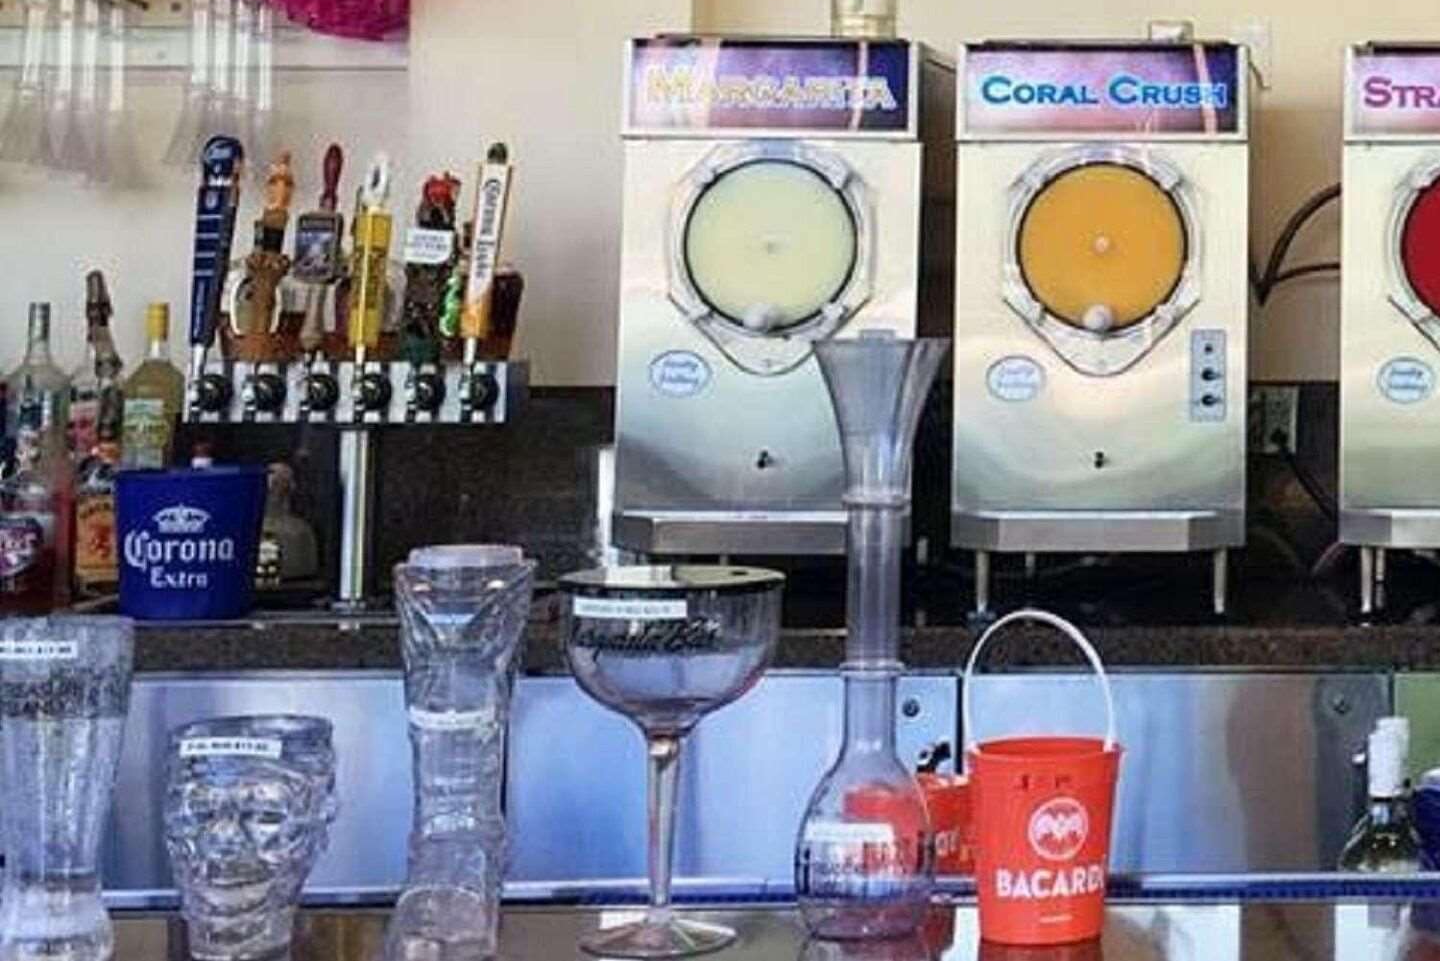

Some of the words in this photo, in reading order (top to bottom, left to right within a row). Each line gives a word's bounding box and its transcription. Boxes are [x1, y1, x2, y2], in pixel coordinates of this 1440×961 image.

[981, 74, 1099, 105] CORAL
[1108, 74, 1227, 108] CRUSH
[124, 528, 235, 572] Corona
[150, 565, 209, 589] Extra
